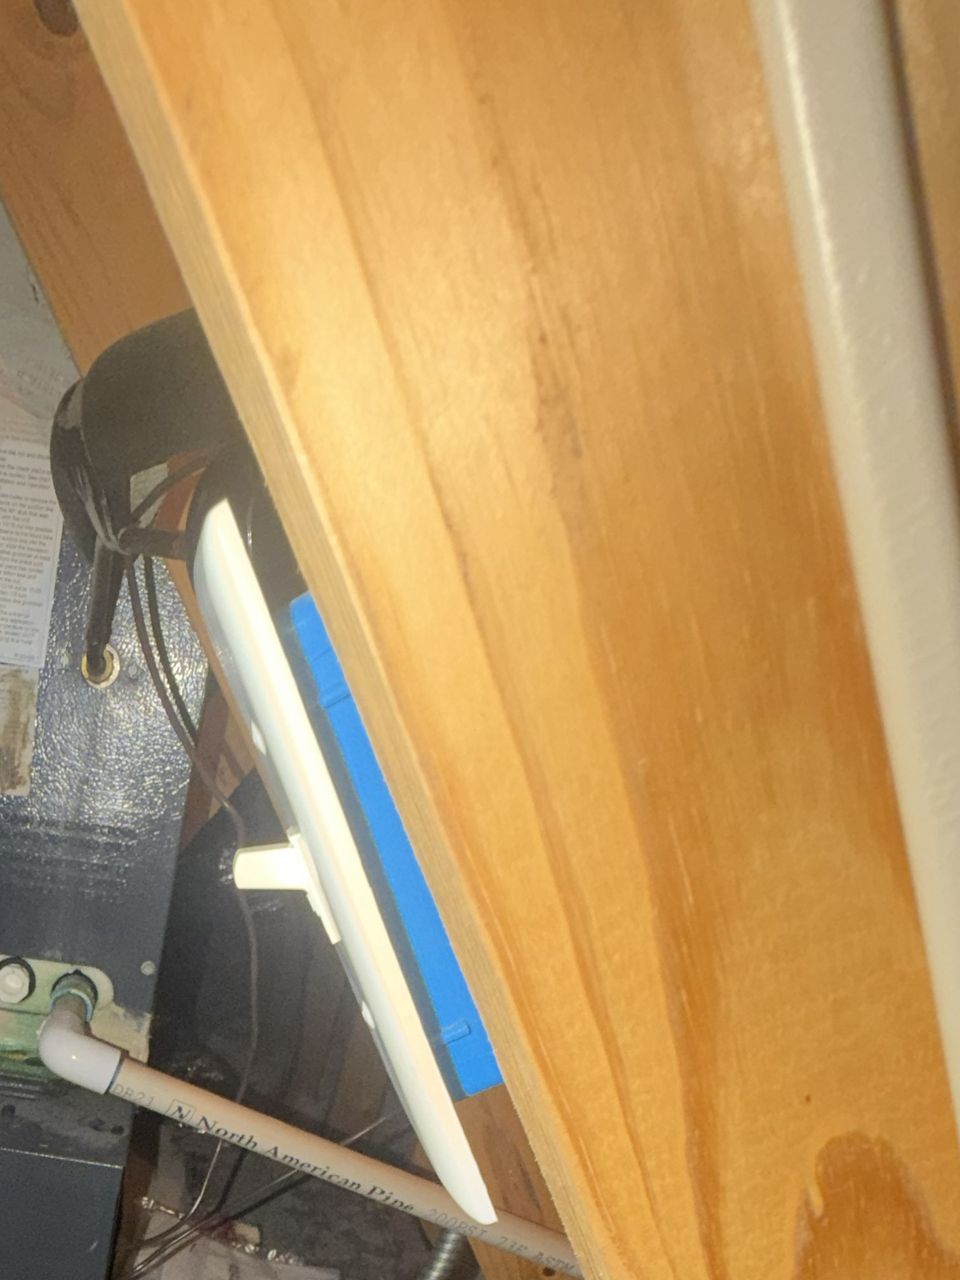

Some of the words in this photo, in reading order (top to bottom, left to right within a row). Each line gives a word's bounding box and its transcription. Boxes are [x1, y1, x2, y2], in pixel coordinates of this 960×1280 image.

[196, 1115, 258, 1149] North
[265, 1146, 362, 1191] American
[425, 1208, 488, 1237] 200PSI
[532, 1250, 576, 1271] ASTM
